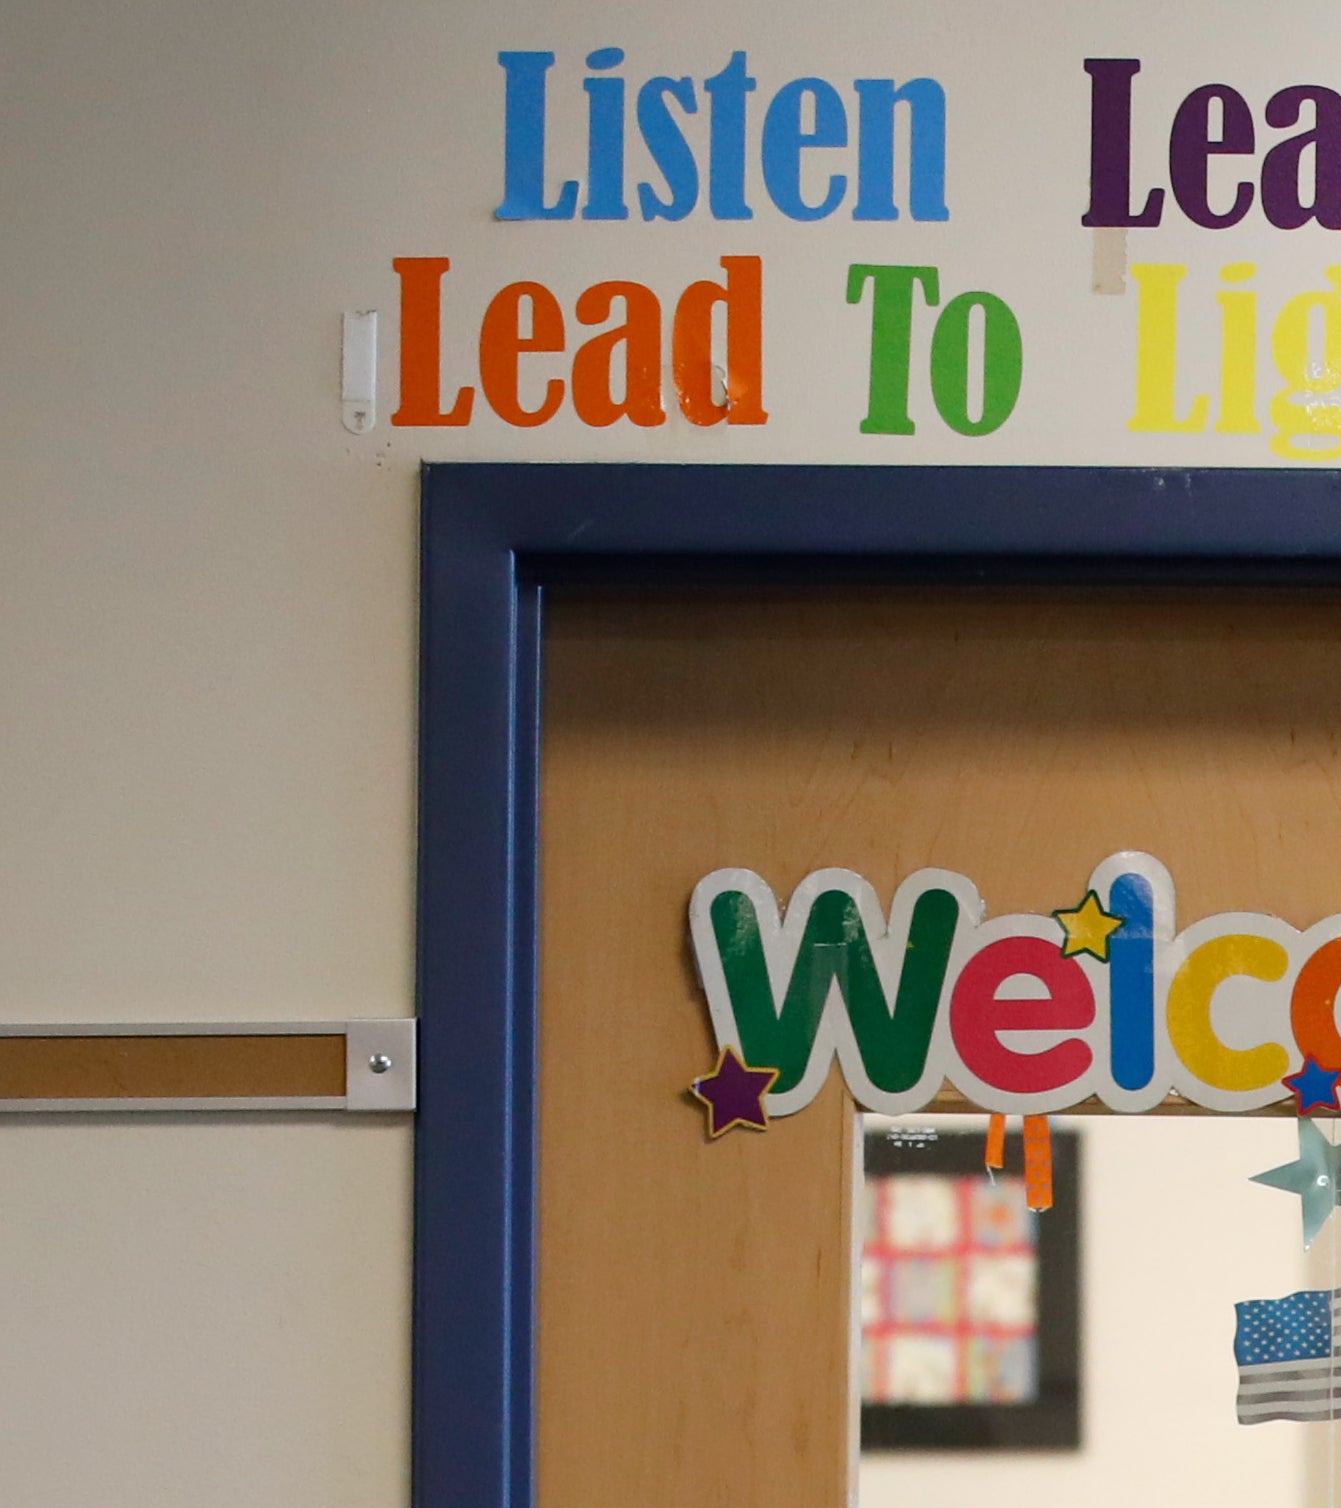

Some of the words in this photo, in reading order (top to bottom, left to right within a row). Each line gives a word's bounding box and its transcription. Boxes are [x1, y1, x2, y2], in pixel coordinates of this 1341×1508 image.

[494, 46, 949, 223] Listen
[390, 255, 769, 428] Lead
[846, 263, 1023, 436] To
